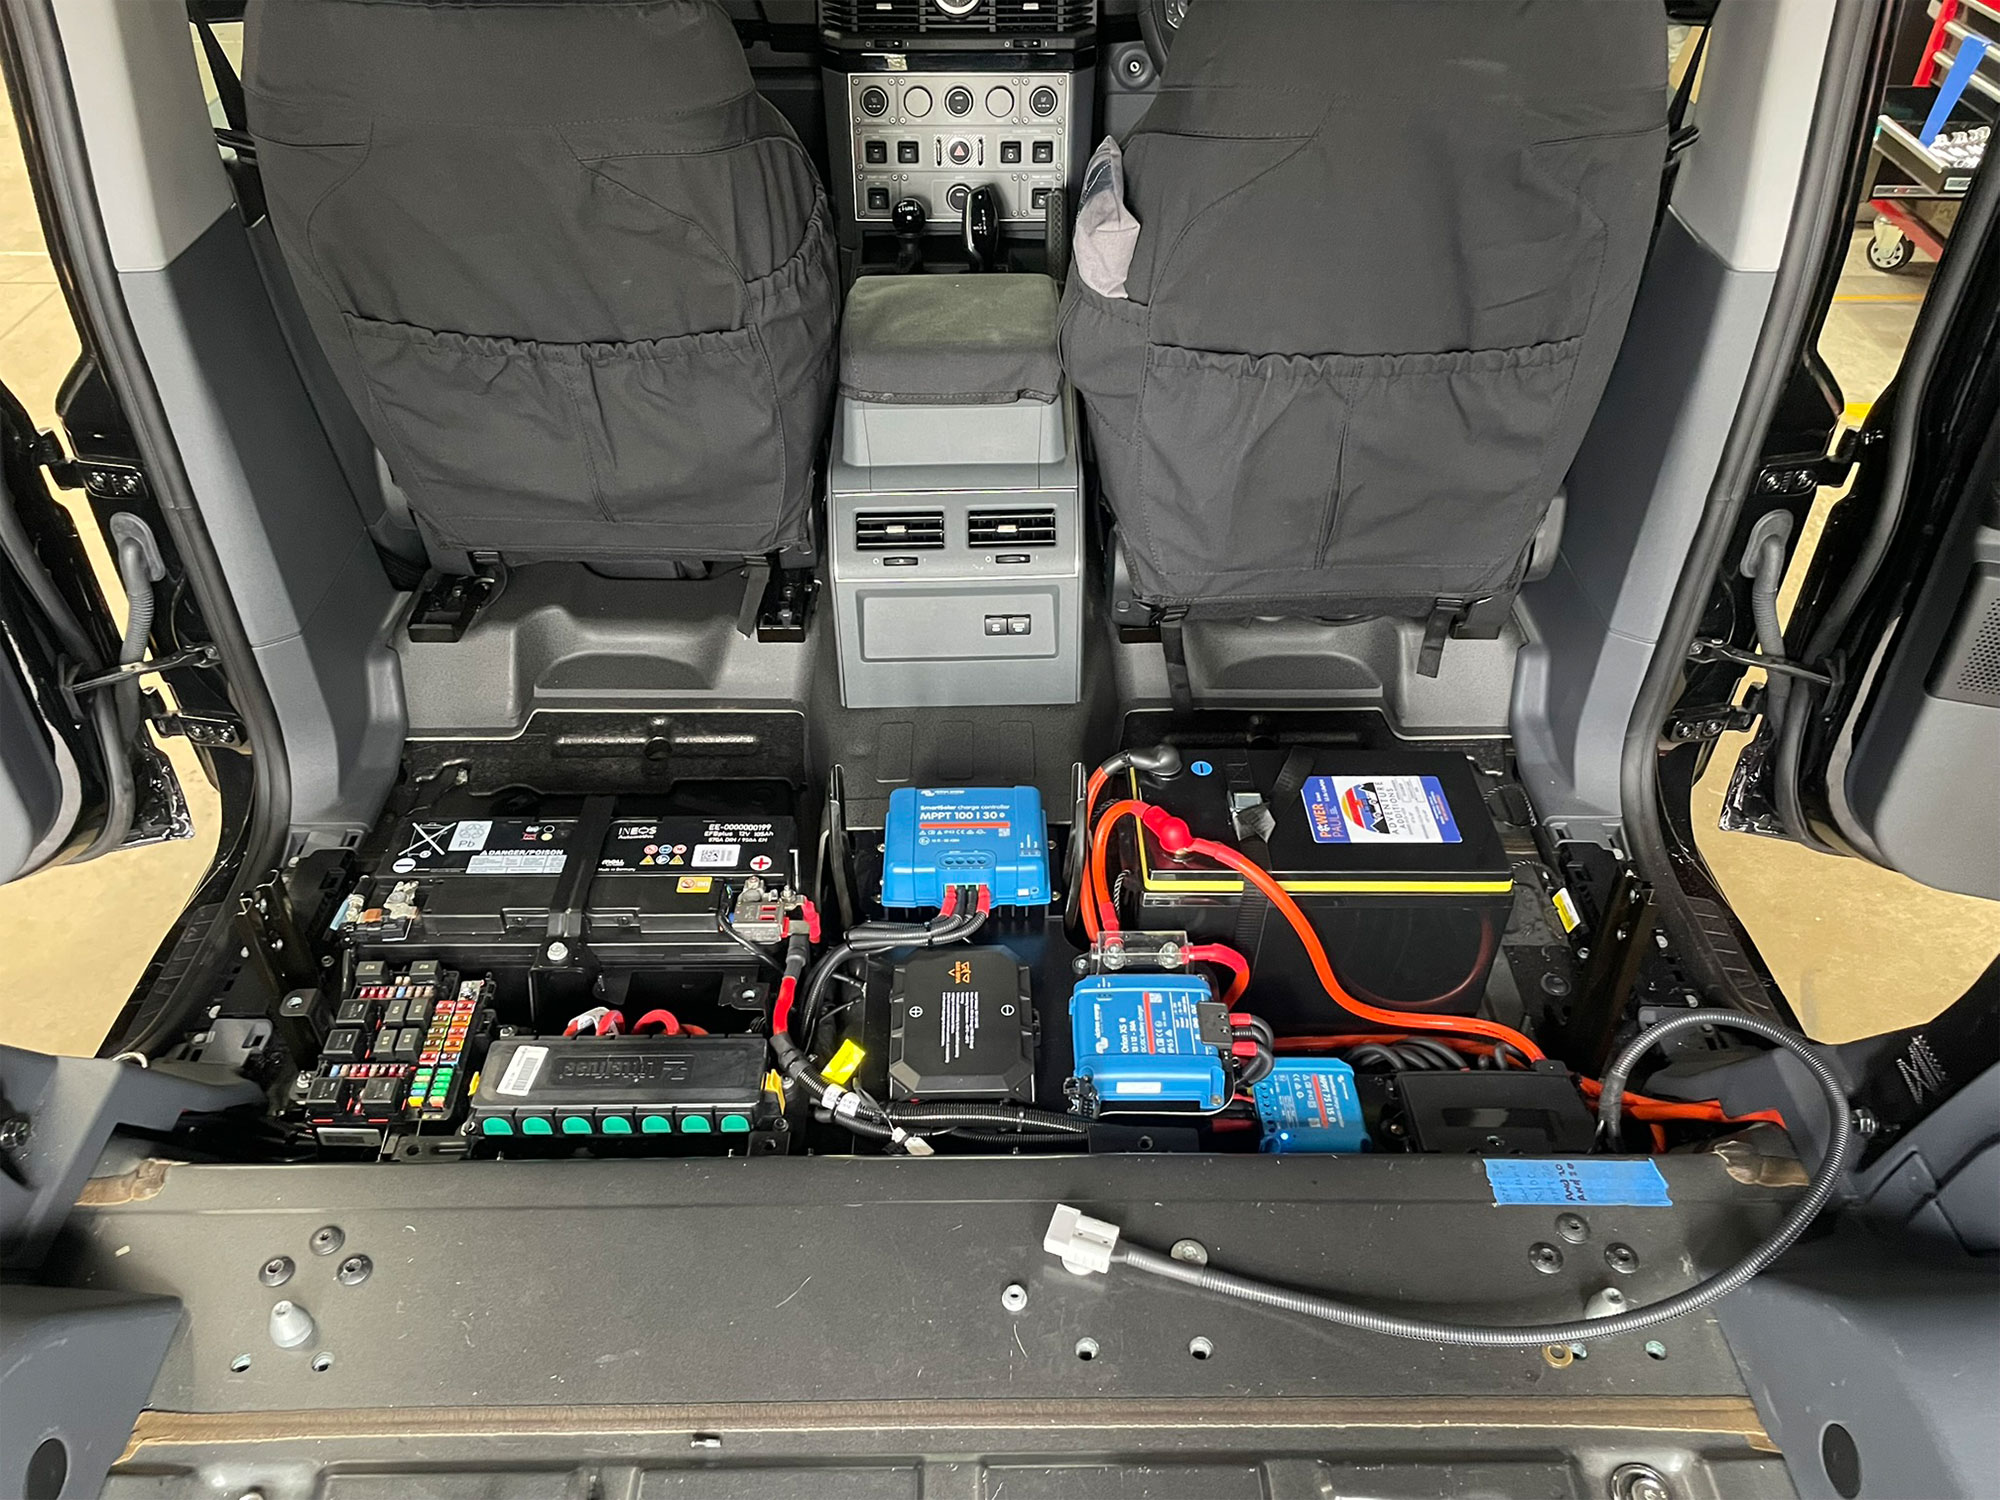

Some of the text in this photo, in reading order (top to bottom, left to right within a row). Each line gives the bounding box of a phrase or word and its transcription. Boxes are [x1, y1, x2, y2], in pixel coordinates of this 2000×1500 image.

[1375, 782, 1399, 834] ADVENTURE
[1386, 788, 1406, 828] ADDITIONS
[920, 812, 951, 820] MPPT
[982, 812, 998, 820] 30
[618, 826, 657, 835] INEOS
[1329, 816, 1344, 838] PAUL
[458, 840, 476, 848] Pb
[1119, 1024, 1129, 1053] Orion XS
[1166, 1039, 1175, 1054] IP65
[1324, 1094, 1332, 1102] 75
